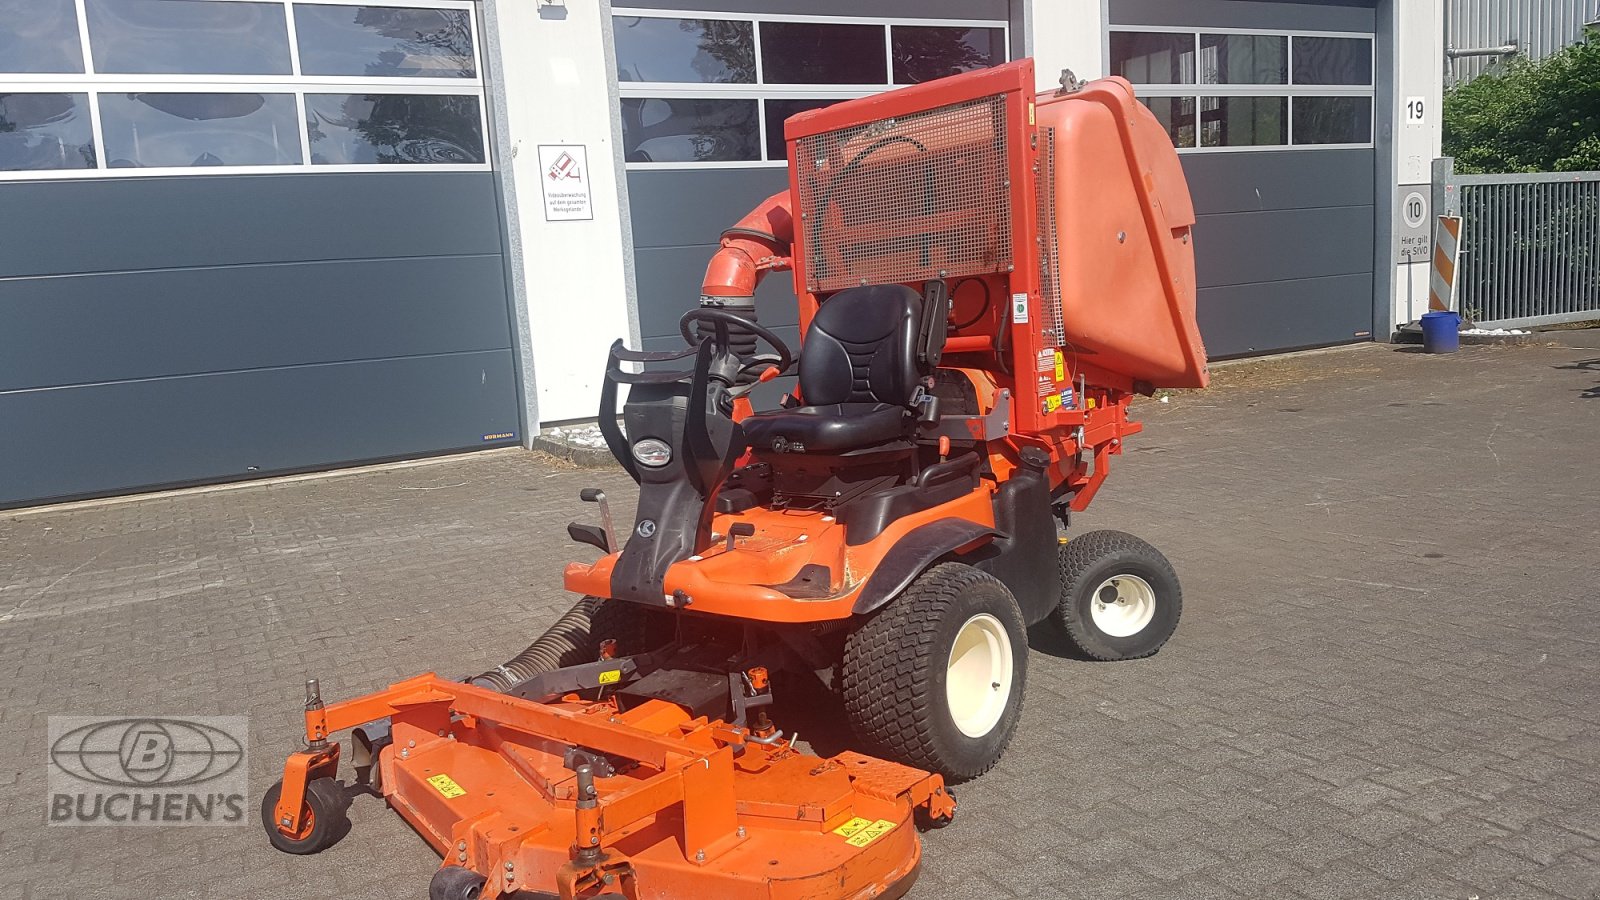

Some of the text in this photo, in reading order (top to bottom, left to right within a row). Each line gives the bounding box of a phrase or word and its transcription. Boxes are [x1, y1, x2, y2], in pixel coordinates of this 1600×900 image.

[1407, 100, 1424, 119] 19
[1409, 202, 1421, 218] 10
[1401, 235, 1428, 245] Hier gilt
[1400, 246, 1428, 256] die StVO
